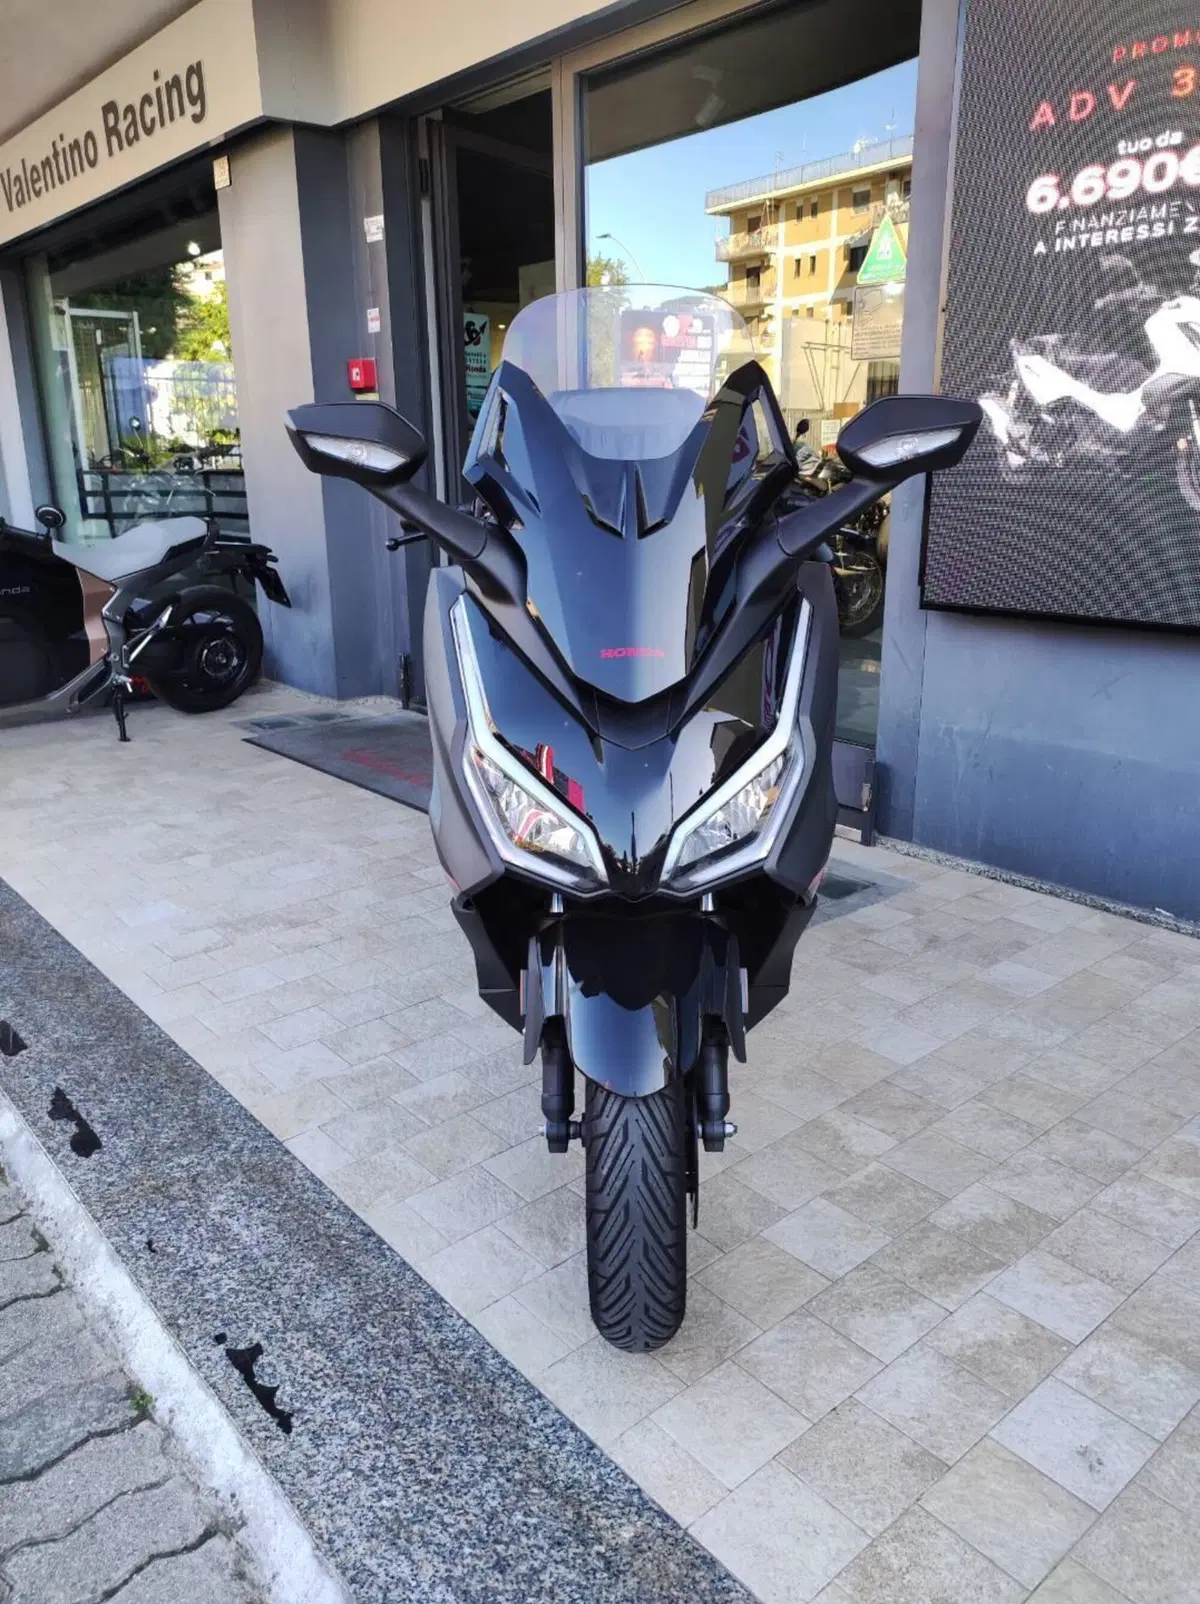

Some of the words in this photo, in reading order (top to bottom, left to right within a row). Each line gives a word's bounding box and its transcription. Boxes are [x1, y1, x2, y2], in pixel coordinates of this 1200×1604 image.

[1113, 28, 1200, 63] PROM
[1030, 79, 1137, 131] ADV
[0, 133, 98, 213] Valentino
[101, 60, 206, 158] Racing
[1117, 136, 1152, 156] tuo
[1155, 130, 1183, 148] da
[1054, 201, 1197, 236] FNANZIAME
[1033, 240, 1047, 255] A
[1054, 218, 1174, 253] INTERESSI
[0, 584, 31, 597] nda
[600, 647, 665, 660] HONDA
